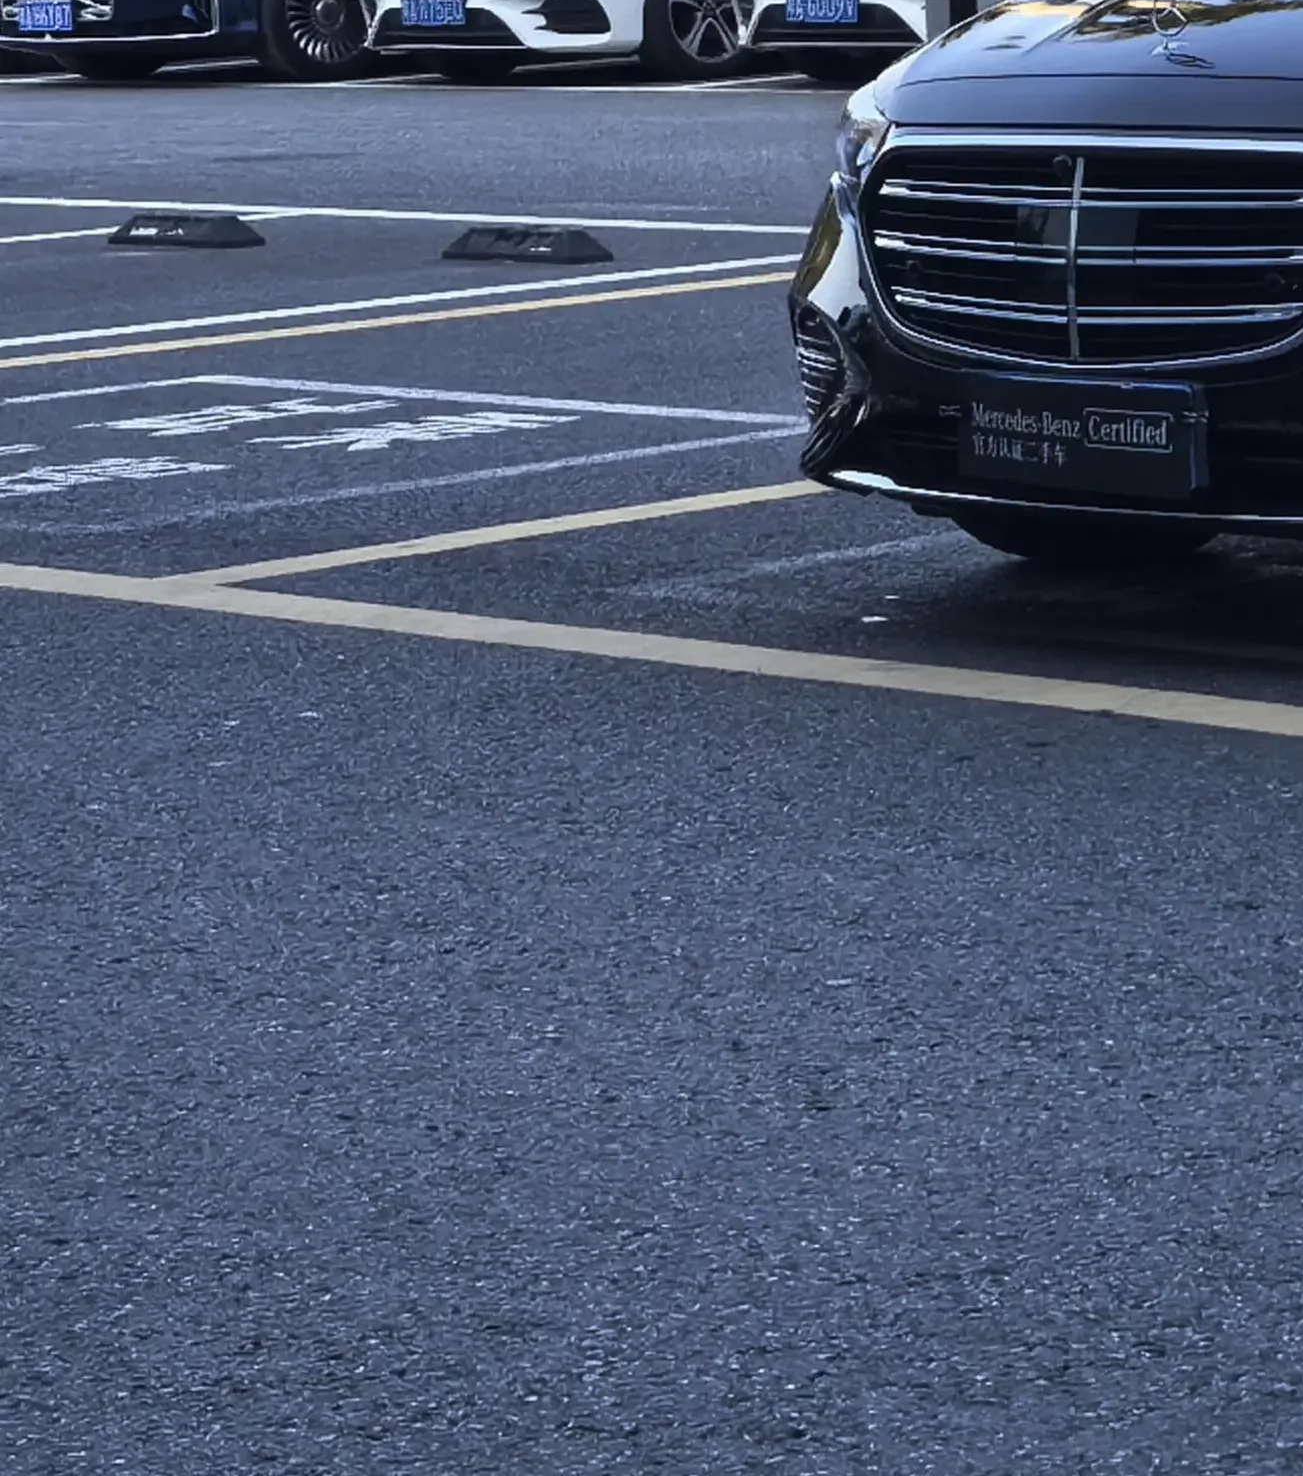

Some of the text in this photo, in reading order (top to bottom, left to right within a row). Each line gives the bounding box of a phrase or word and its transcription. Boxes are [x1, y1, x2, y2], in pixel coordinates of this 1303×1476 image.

[971, 402, 1166, 446] Mercedes-Benz Certified
[972, 432, 1067, 467] 官方认证二手车
